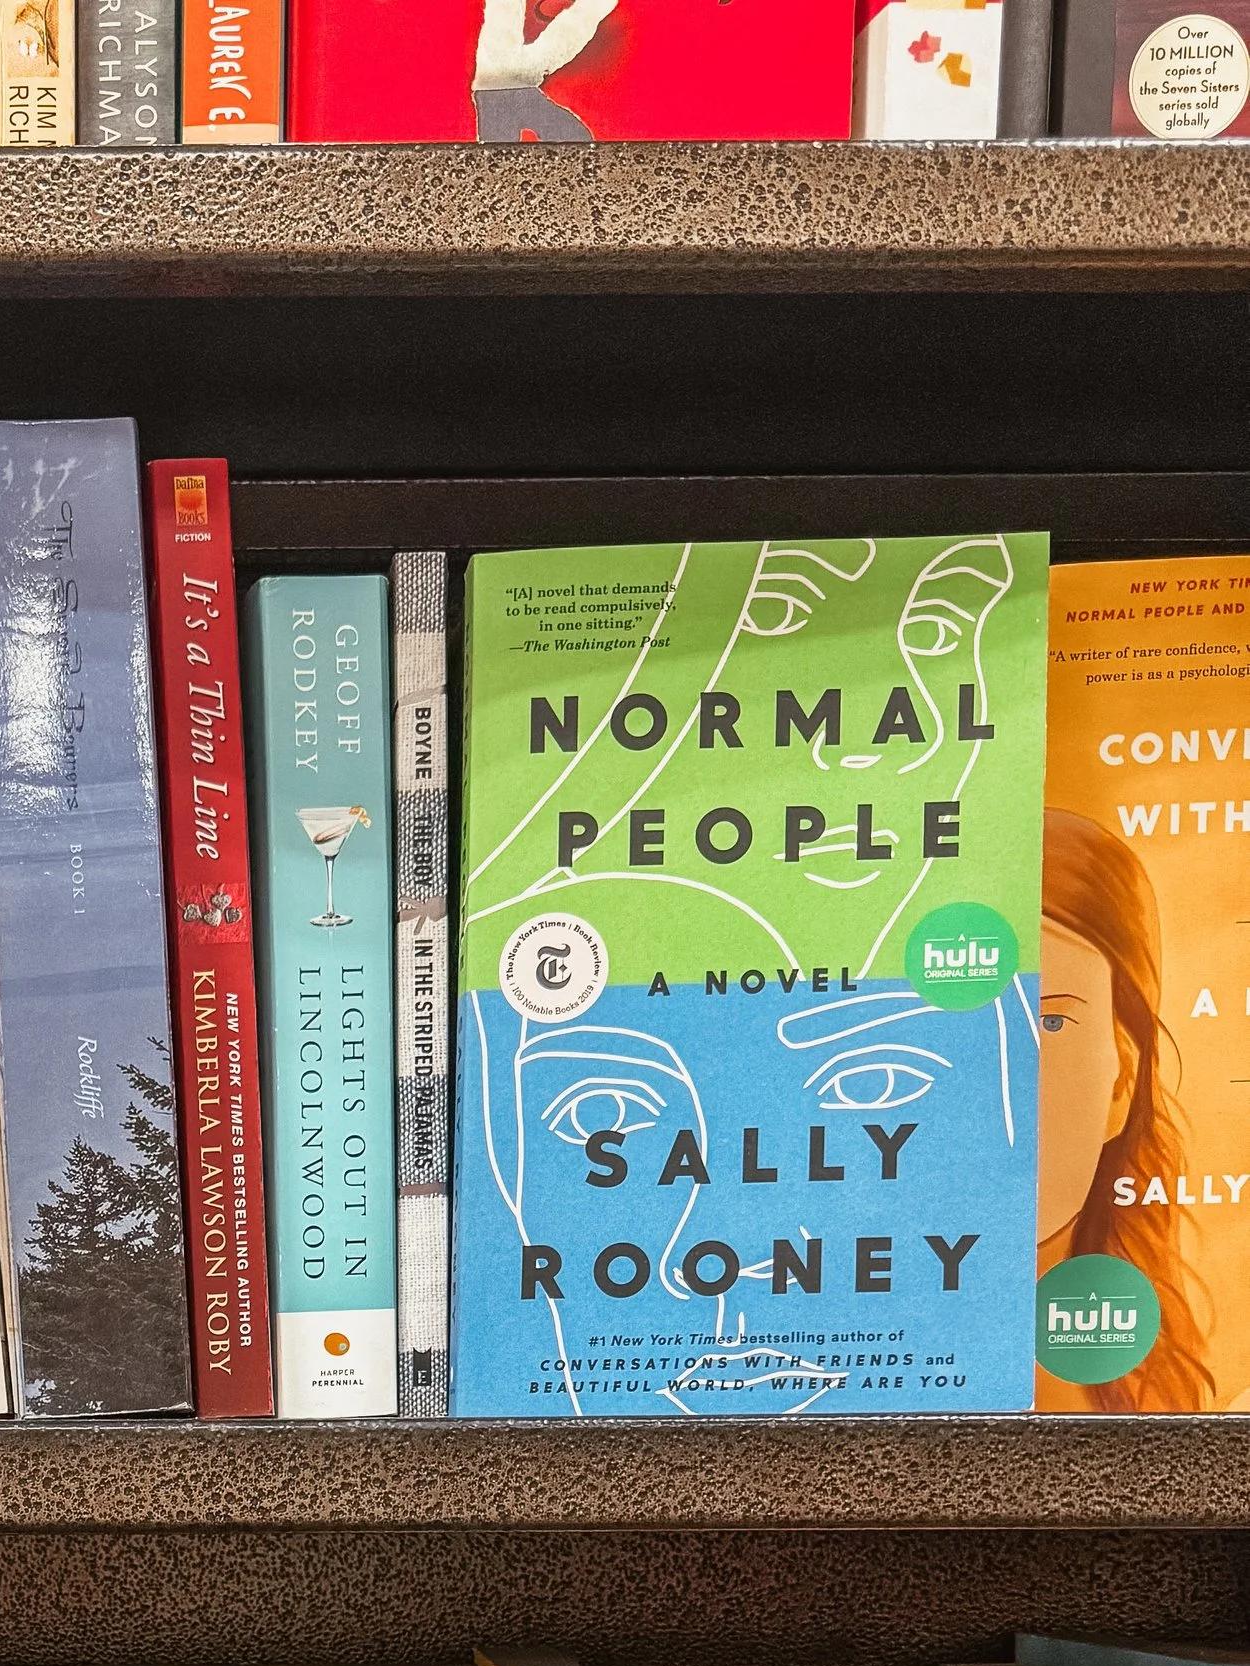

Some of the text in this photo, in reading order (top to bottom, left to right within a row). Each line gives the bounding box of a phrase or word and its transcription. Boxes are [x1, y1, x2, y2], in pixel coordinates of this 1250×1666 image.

[1178, 25, 1209, 40] Over
[1150, 45, 1233, 61] 10 MILLION
[1165, 60, 1216, 79] copies of
[1140, 80, 1239, 95] the Seven Sisters
[1159, 96, 1219, 112] series sold
[1166, 112, 1210, 130] globally
[537, 586, 576, 598] novel
[580, 584, 609, 596] that
[612, 581, 677, 595] demands
[506, 599, 676, 616] to be read compulsively,
[539, 621, 553, 631] in
[557, 621, 582, 630] one
[554, 638, 635, 651] Washington
[640, 637, 670, 649] Post
[1070, 649, 1110, 661] writer
[1116, 647, 1129, 658] of
[1133, 649, 1161, 658] rare
[1166, 643, 1240, 656] confidence,
[1086, 670, 1174, 685] power is as a
[292, 608, 318, 774] RODKEY
[335, 625, 362, 754] GEOFF
[530, 684, 994, 753] NORMAL
[558, 801, 960, 867] PEOPLE
[300, 968, 325, 1279] LINCOLNWOOD
[342, 965, 367, 1278] LIGHTS OUT IN
[585, 1123, 918, 1188] SALLY
[521, 1234, 981, 1300] ROONEY
[1048, 1304, 1137, 1331] hulu
[1048, 1333, 1135, 1343] ORIGINAL SERIES
